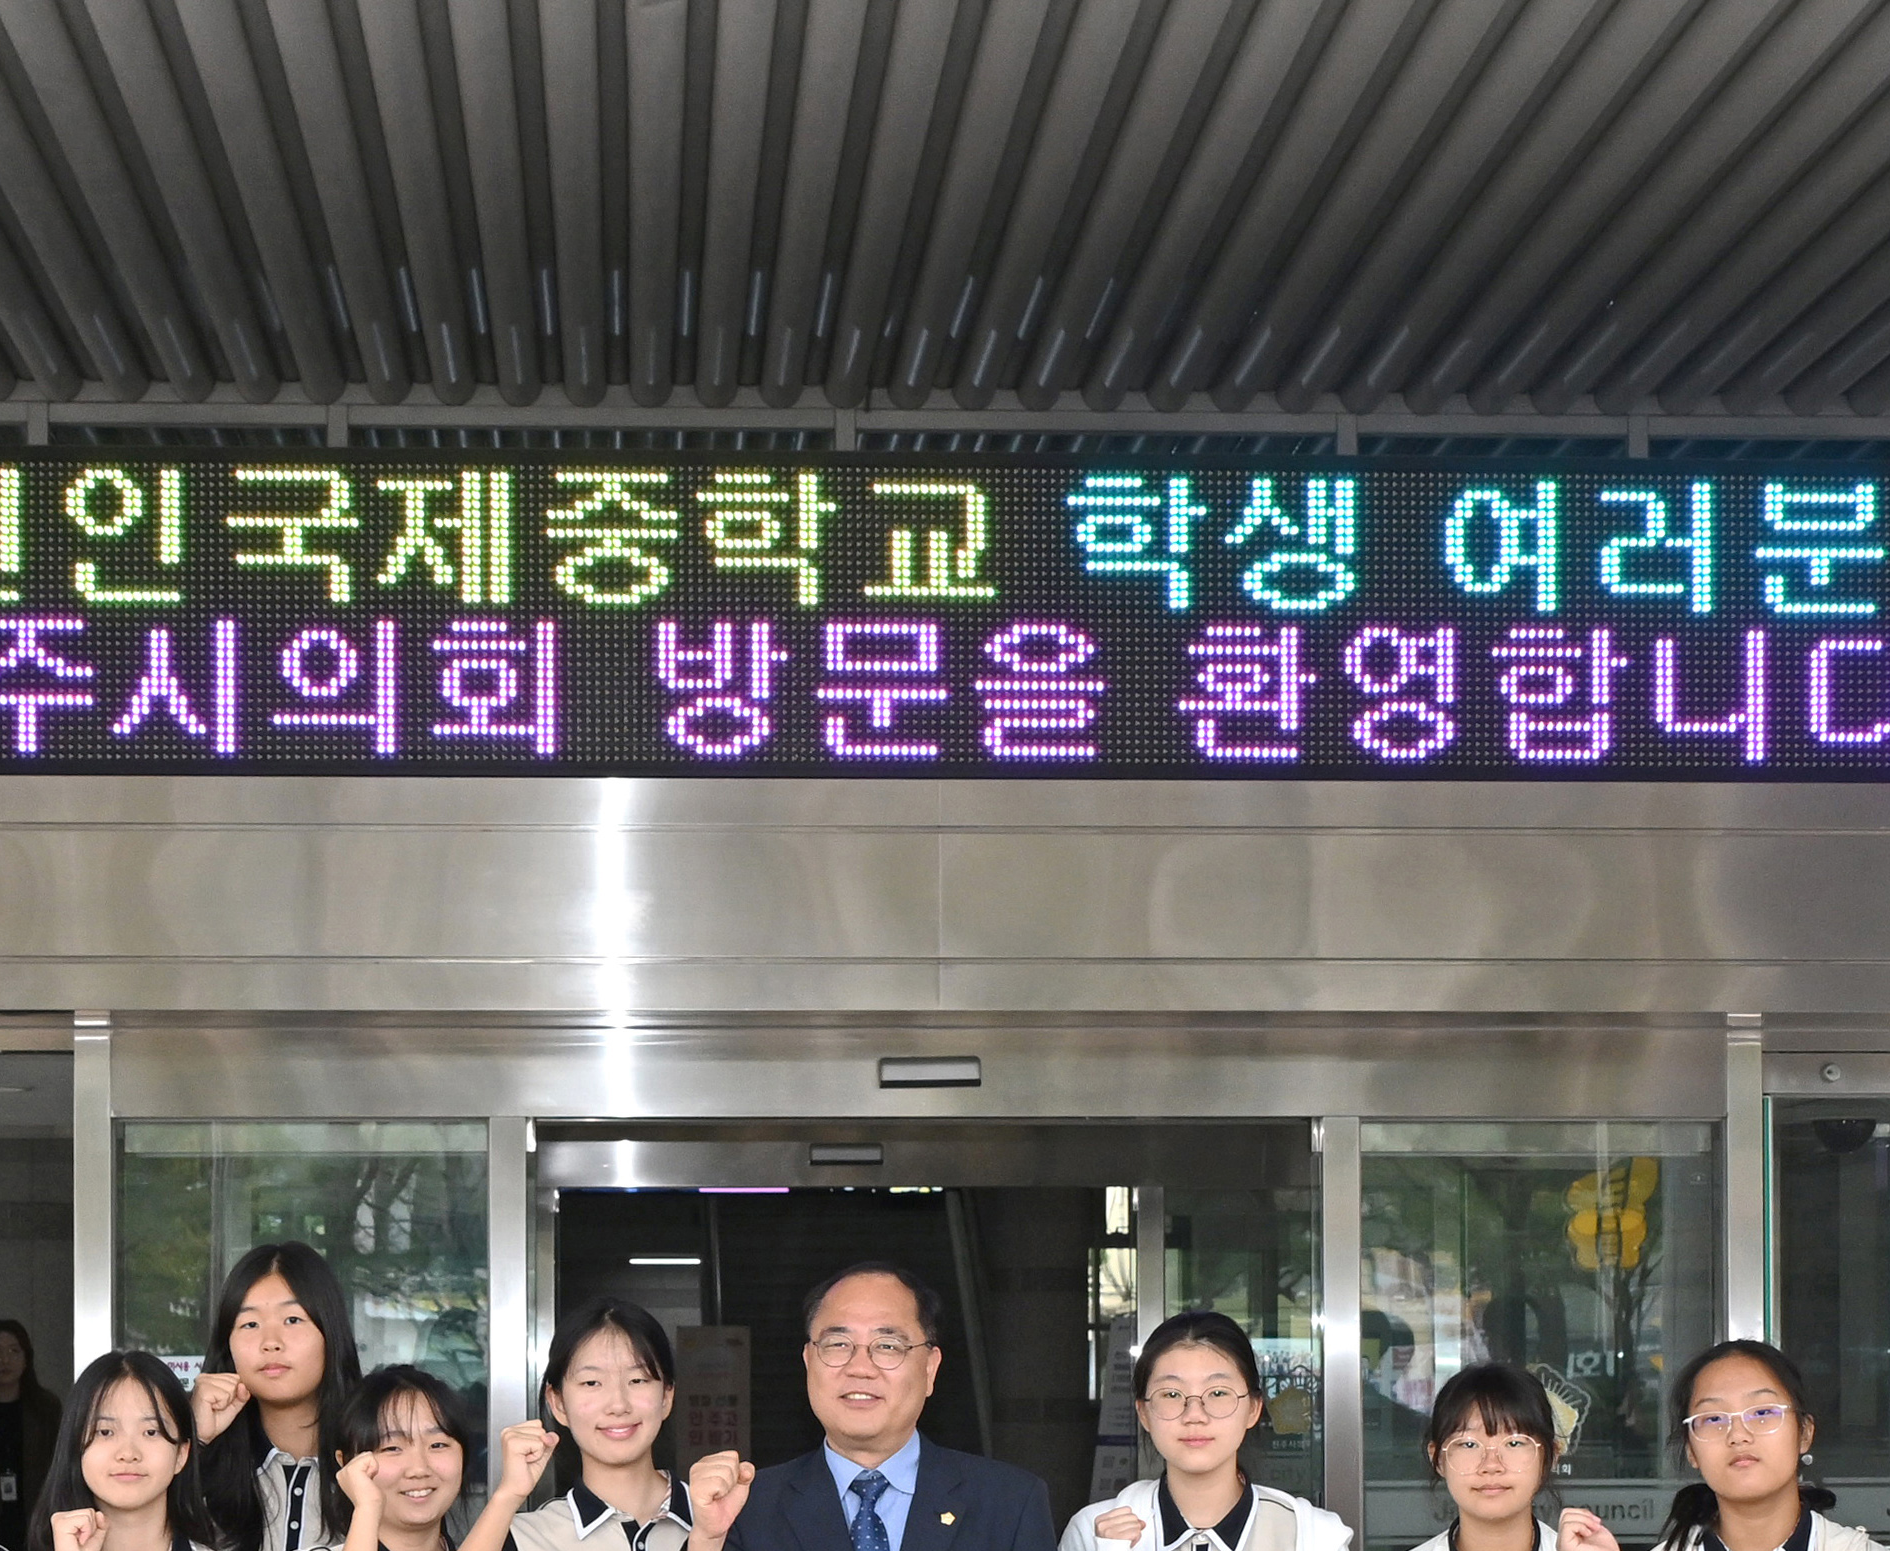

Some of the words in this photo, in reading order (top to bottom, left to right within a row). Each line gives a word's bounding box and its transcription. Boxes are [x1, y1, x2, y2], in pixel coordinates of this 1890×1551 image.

[1066, 476, 1355, 610] 학생
[1443, 480, 1885, 614] 여러분
[657, 620, 1105, 758] 방문을
